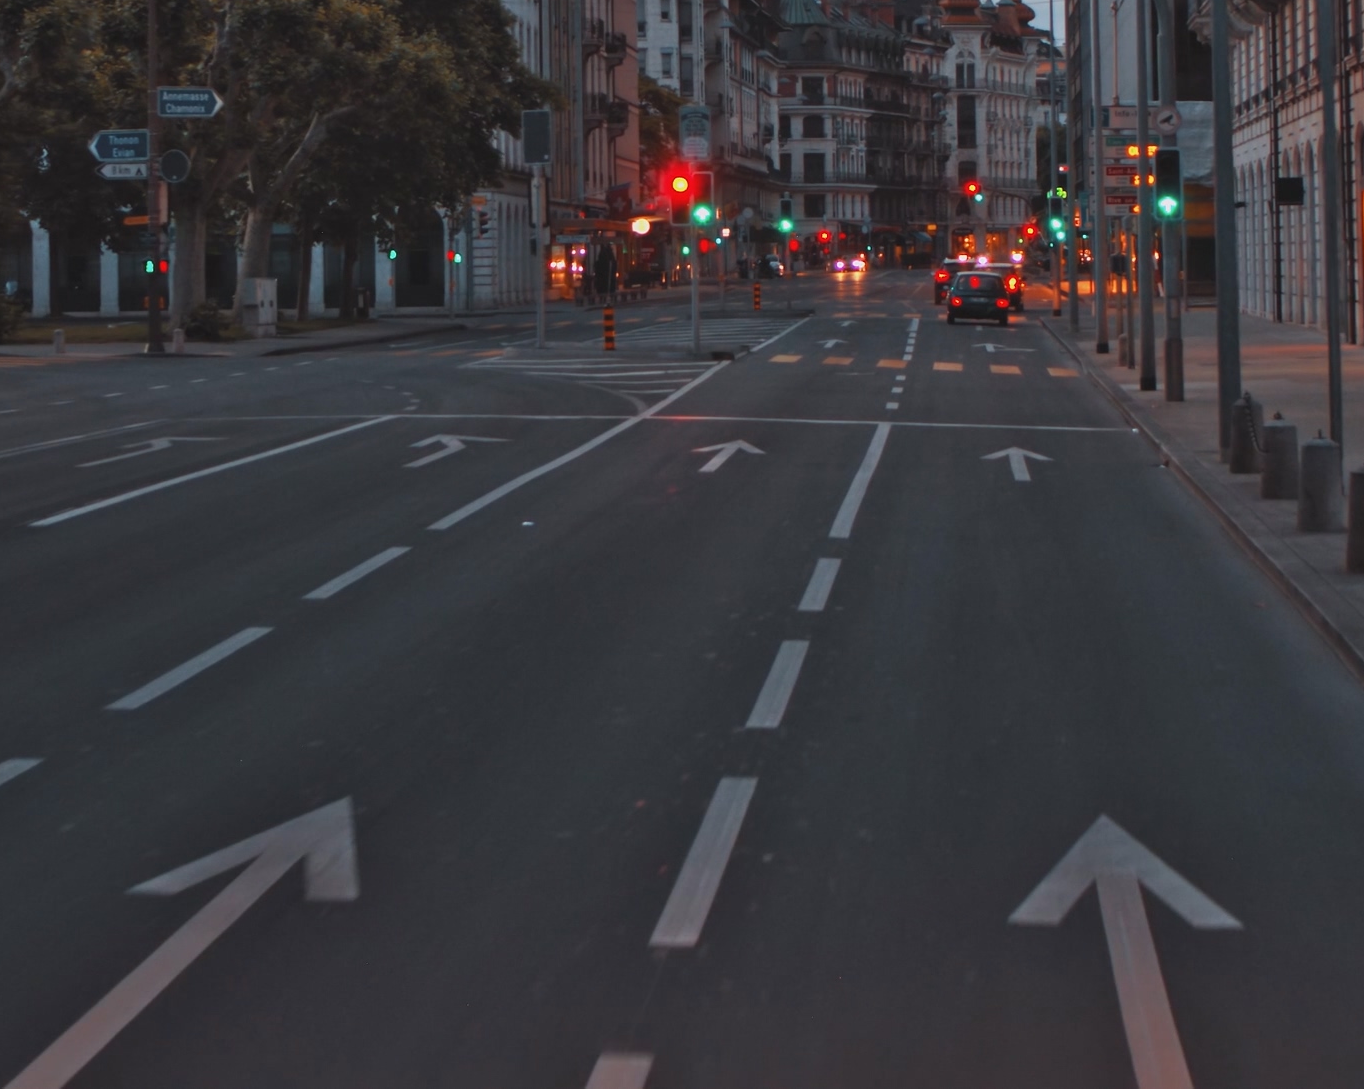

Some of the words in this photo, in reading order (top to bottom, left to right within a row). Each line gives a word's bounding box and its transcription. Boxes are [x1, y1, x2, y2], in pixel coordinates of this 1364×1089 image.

[162, 91, 209, 101] Annemasse
[165, 103, 205, 113] Chamonix
[112, 147, 135, 158] Evian
